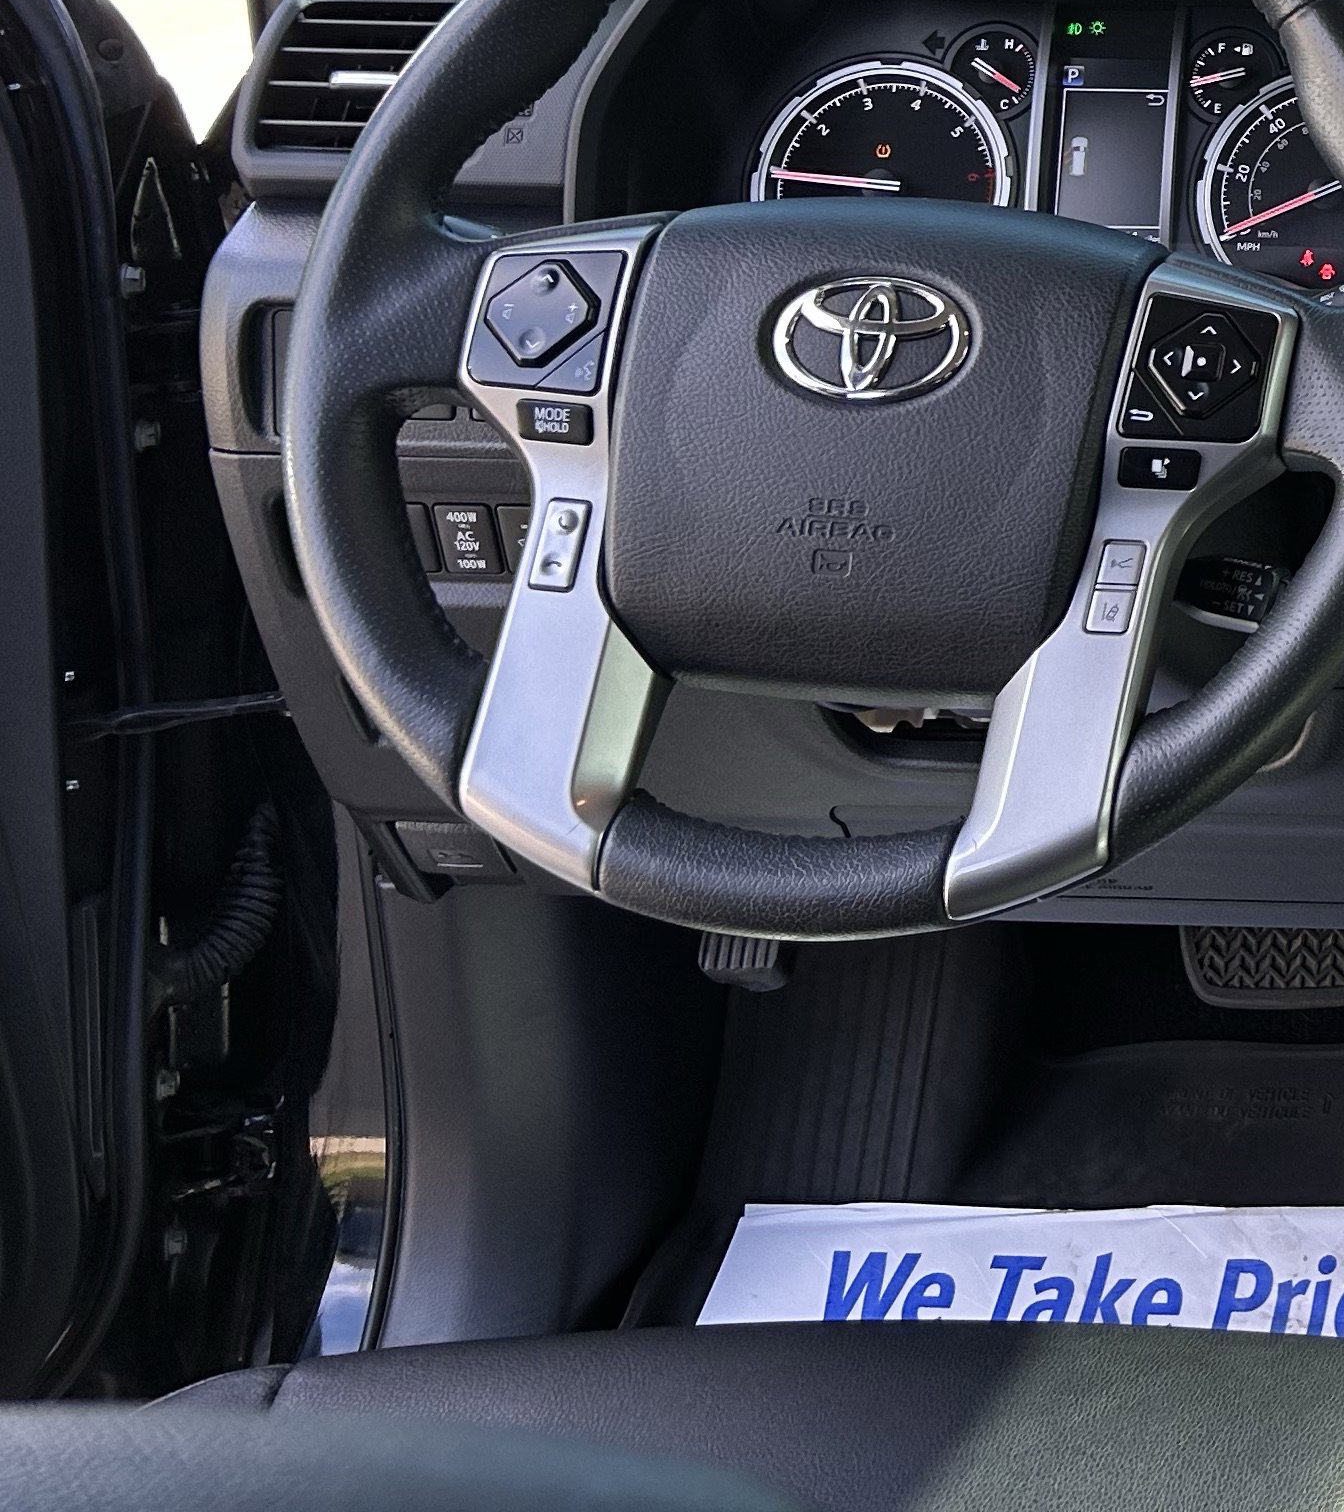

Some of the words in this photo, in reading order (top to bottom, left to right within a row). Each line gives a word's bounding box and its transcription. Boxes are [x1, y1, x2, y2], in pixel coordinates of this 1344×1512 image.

[1004, 39, 1015, 50] H
[1217, 43, 1226, 54] F
[1067, 69, 1080, 83] P
[863, 98, 874, 111] 3
[910, 99, 922, 111] 4
[1000, 99, 1010, 110] C
[1214, 103, 1222, 114] E
[817, 123, 831, 136] 2
[950, 126, 964, 138] 5
[1268, 118, 1287, 135] 40
[1276, 138, 1290, 150] 60
[1259, 160, 1271, 174] 40
[1236, 163, 1251, 184] 20
[1253, 188, 1263, 201] 20
[1257, 229, 1279, 240] km/h
[1236, 241, 1261, 252] MPH
[534, 407, 571, 422] MODE
[544, 422, 570, 434] HOLD
[446, 511, 477, 522] 400W
[457, 531, 475, 541] AC
[777, 517, 897, 543] AIRBAG
[454, 541, 480, 551] 120V
[457, 559, 486, 569] 100W
[1232, 569, 1254, 583] RES
[1224, 600, 1245, 615] SET
[821, 1249, 956, 1324] We
[989, 1252, 1184, 1326] Take
